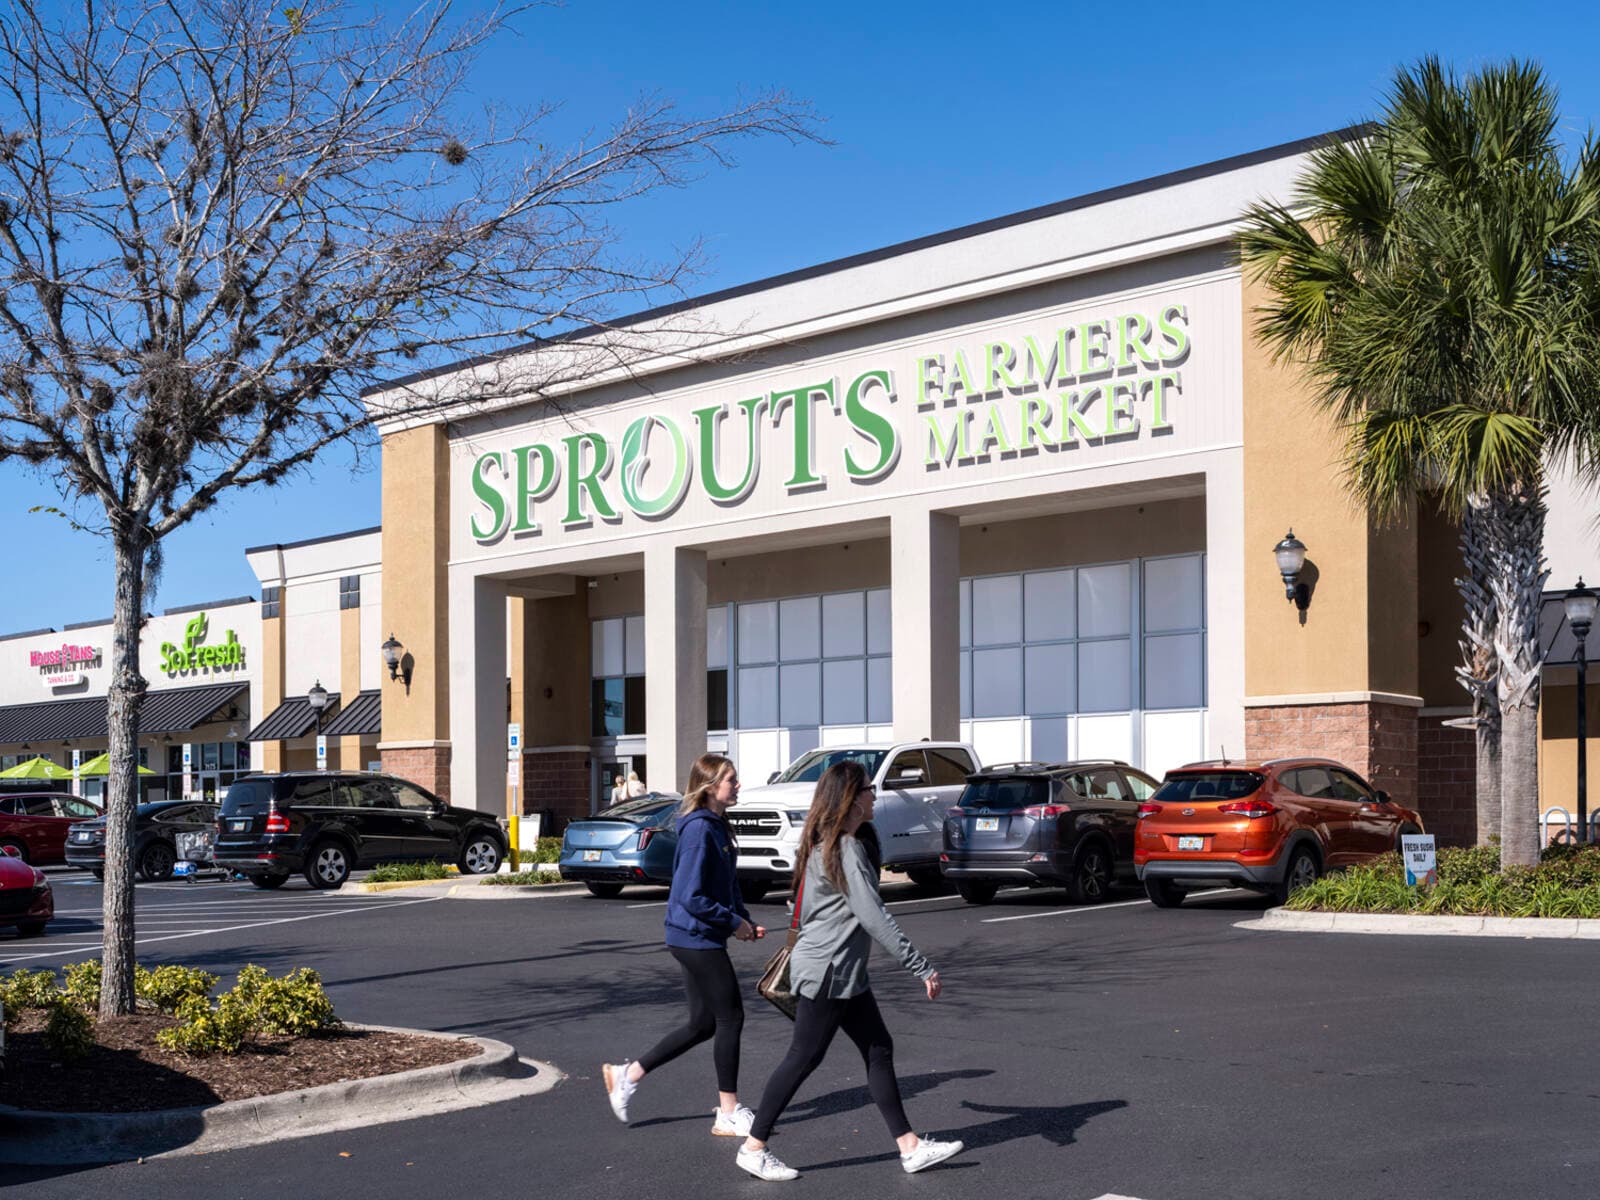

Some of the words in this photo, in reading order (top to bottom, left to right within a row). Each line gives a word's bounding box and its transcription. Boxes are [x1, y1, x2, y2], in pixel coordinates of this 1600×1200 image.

[914, 304, 1188, 407] FARMERS
[923, 372, 1181, 468] MARKET
[470, 369, 898, 543] SPROUTS
[30, 649, 61, 667] HOUSE
[68, 645, 93, 662] TANS
[1404, 843, 1419, 852] FRESH
[1420, 843, 1434, 851] SUSHI
[1413, 853, 1426, 862] DAILY
